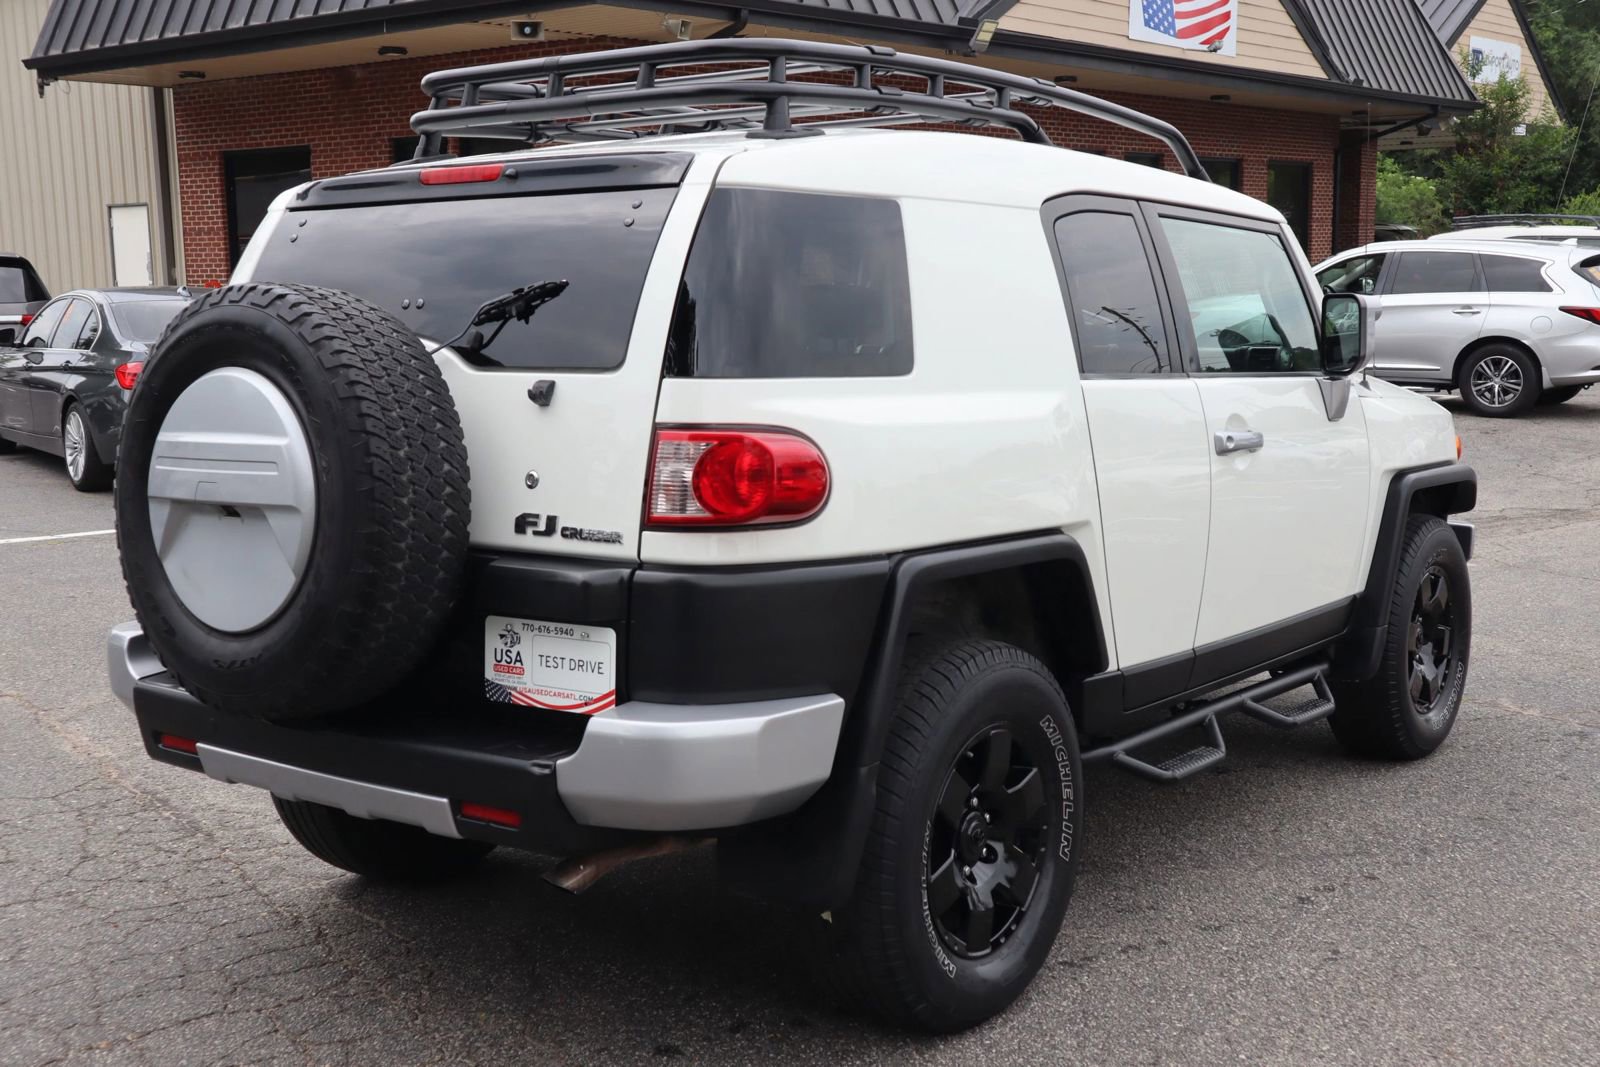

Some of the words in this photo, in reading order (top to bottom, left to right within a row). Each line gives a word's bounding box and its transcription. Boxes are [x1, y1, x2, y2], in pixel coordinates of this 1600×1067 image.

[514, 512, 558, 537] FJ
[560, 526, 624, 544] CRUISER
[522, 622, 575, 638] 770-676-5940
[494, 647, 524, 667] USA
[538, 654, 566, 671] TEST
[569, 658, 605, 675] DRIVE
[494, 665, 509, 673] USED
[509, 667, 525, 675] CARS
[1040, 714, 1074, 862] MICHELIN
[920, 819, 957, 978] MICHELIN
